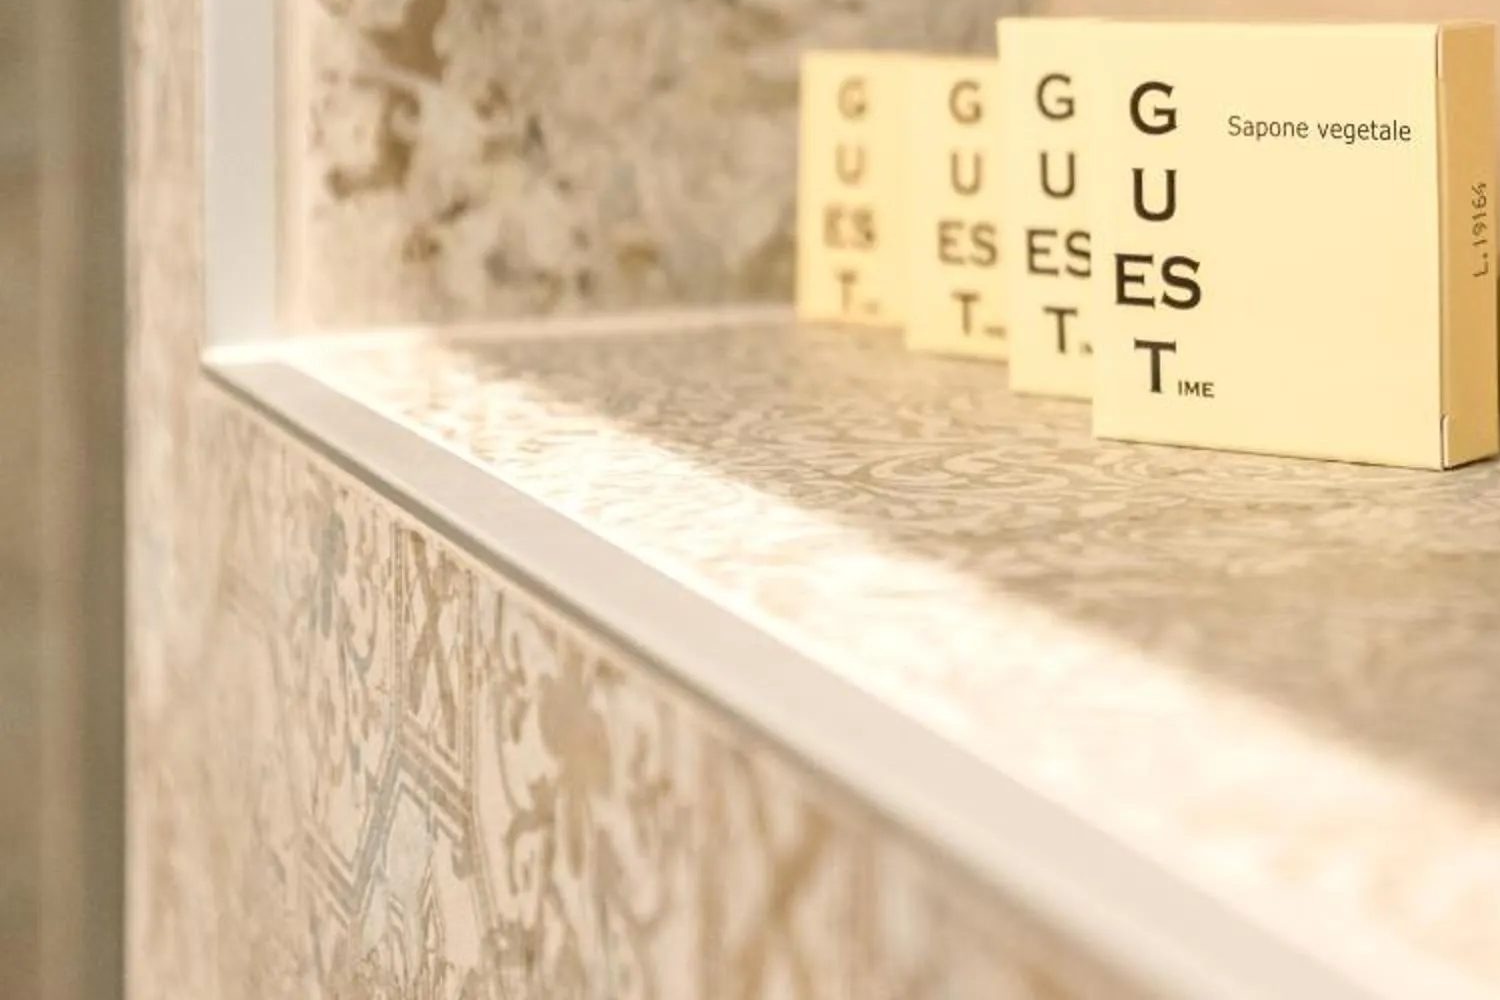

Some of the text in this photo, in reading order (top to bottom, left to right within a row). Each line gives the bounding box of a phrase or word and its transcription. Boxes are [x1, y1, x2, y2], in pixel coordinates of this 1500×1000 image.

[949, 79, 983, 125] G
[1037, 72, 1075, 121] G
[1129, 81, 1178, 135] G
[1228, 115, 1412, 145] Sapone vegetale
[950, 150, 983, 196] U
[1040, 151, 1077, 199] U
[1132, 167, 1177, 222] U
[937, 219, 999, 267] ES
[1026, 228, 1092, 279] ES
[1114, 253, 1202, 310] ES
